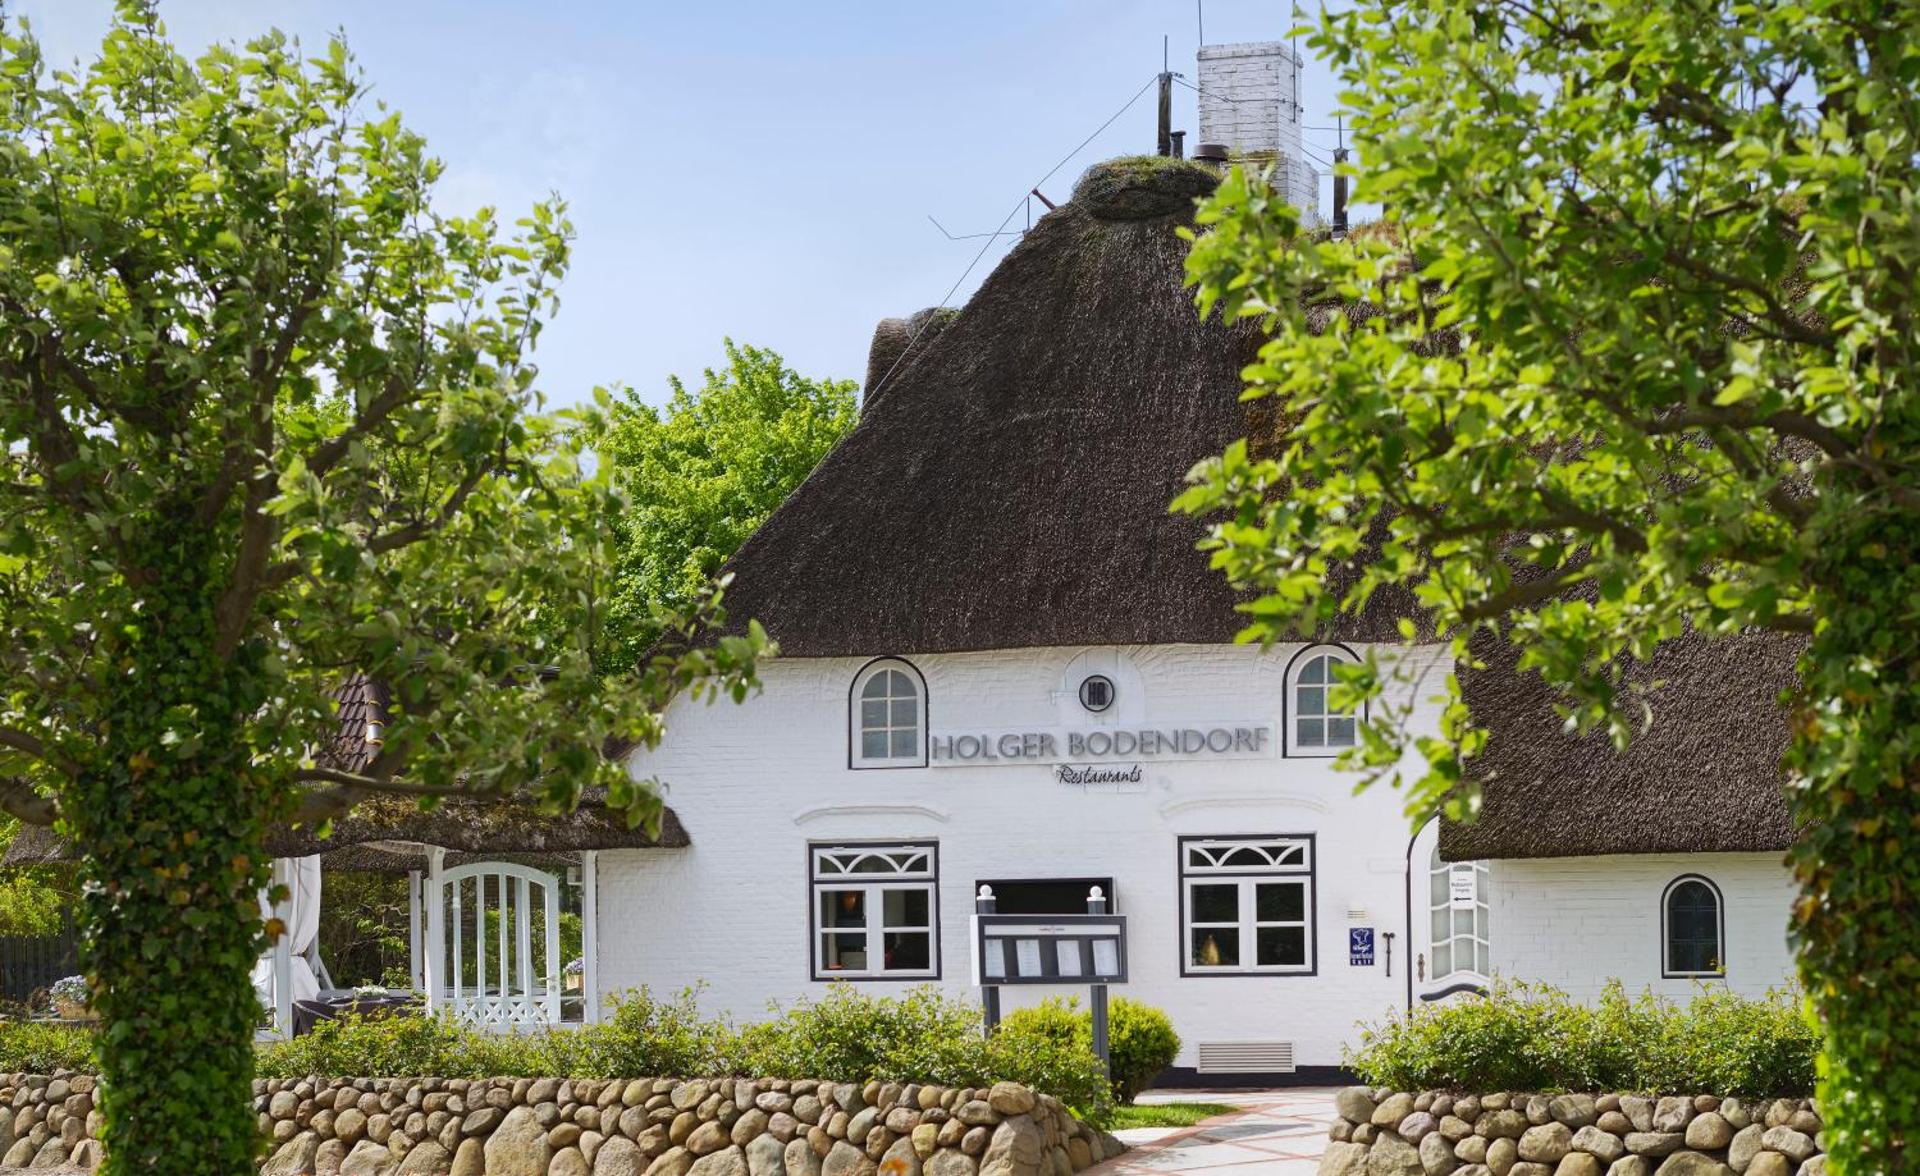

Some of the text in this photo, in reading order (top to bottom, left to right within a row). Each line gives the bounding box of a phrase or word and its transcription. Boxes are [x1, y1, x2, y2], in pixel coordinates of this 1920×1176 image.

[932, 727, 1269, 760] HOLGER BODENDORF
[1057, 764, 1142, 784] Restaurants
